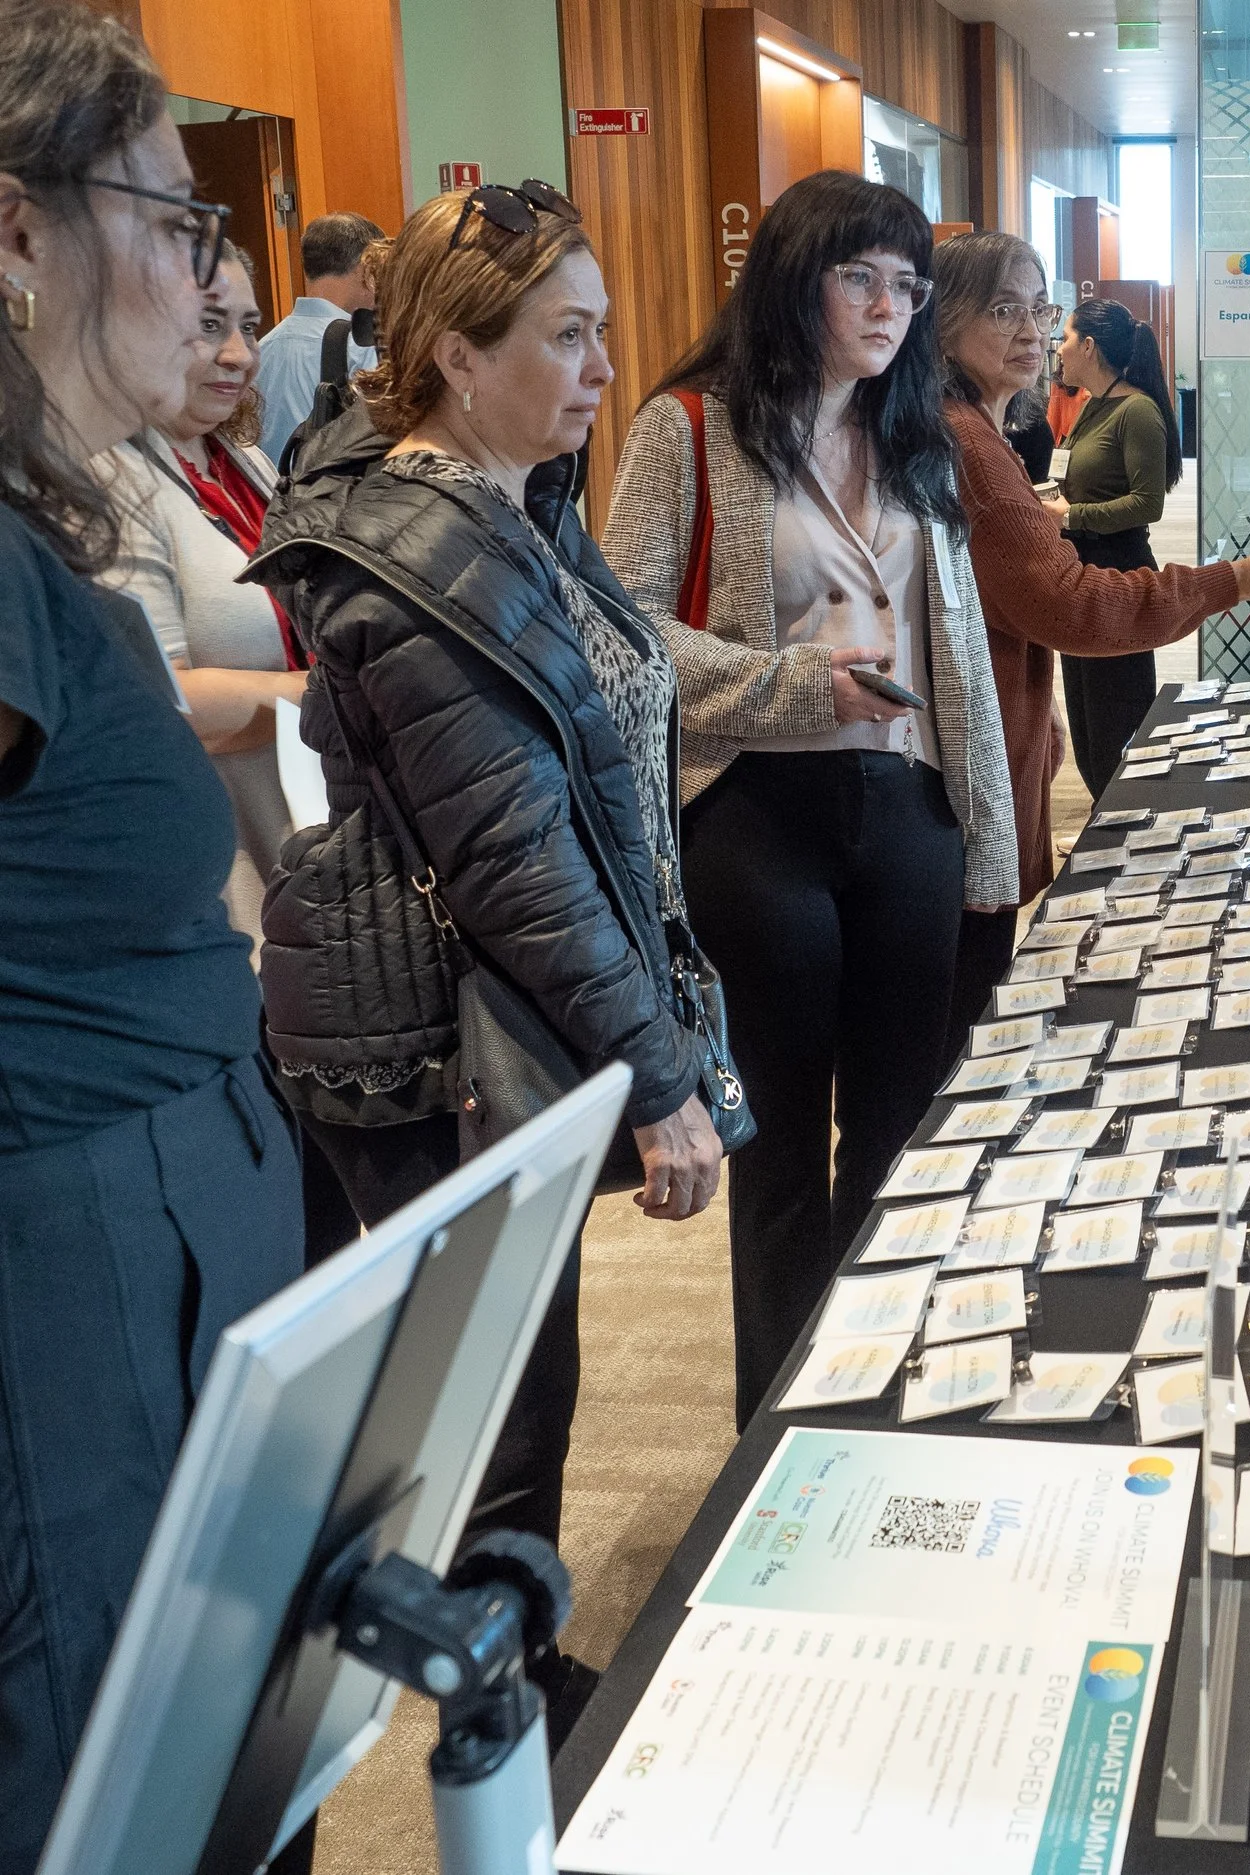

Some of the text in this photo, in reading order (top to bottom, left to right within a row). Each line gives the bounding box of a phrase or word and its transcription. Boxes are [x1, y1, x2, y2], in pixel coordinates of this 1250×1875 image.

[579, 113, 593, 122] Fire
[580, 123, 623, 134] Extinguisher
[721, 203, 750, 289] C104
[1080, 280, 1094, 300] C1
[1090, 1467, 1115, 1497] JOIN
[1083, 1499, 1107, 1518] US
[745, 1519, 774, 1551] Stanford
[771, 1524, 805, 1553] CRC
[974, 1498, 1023, 1561] Whova
[1076, 1520, 1102, 1543] ON
[1123, 1502, 1156, 1565] CLIMATE
[1057, 1546, 1094, 1610] WHOVA!
[1107, 1566, 1142, 1631] SUMMIT
[1034, 1673, 1071, 1731] EVENT
[622, 1743, 662, 1780] CRC
[1095, 1711, 1133, 1795] CLIMATE
[1002, 1734, 1056, 1845] SCHEDULE
